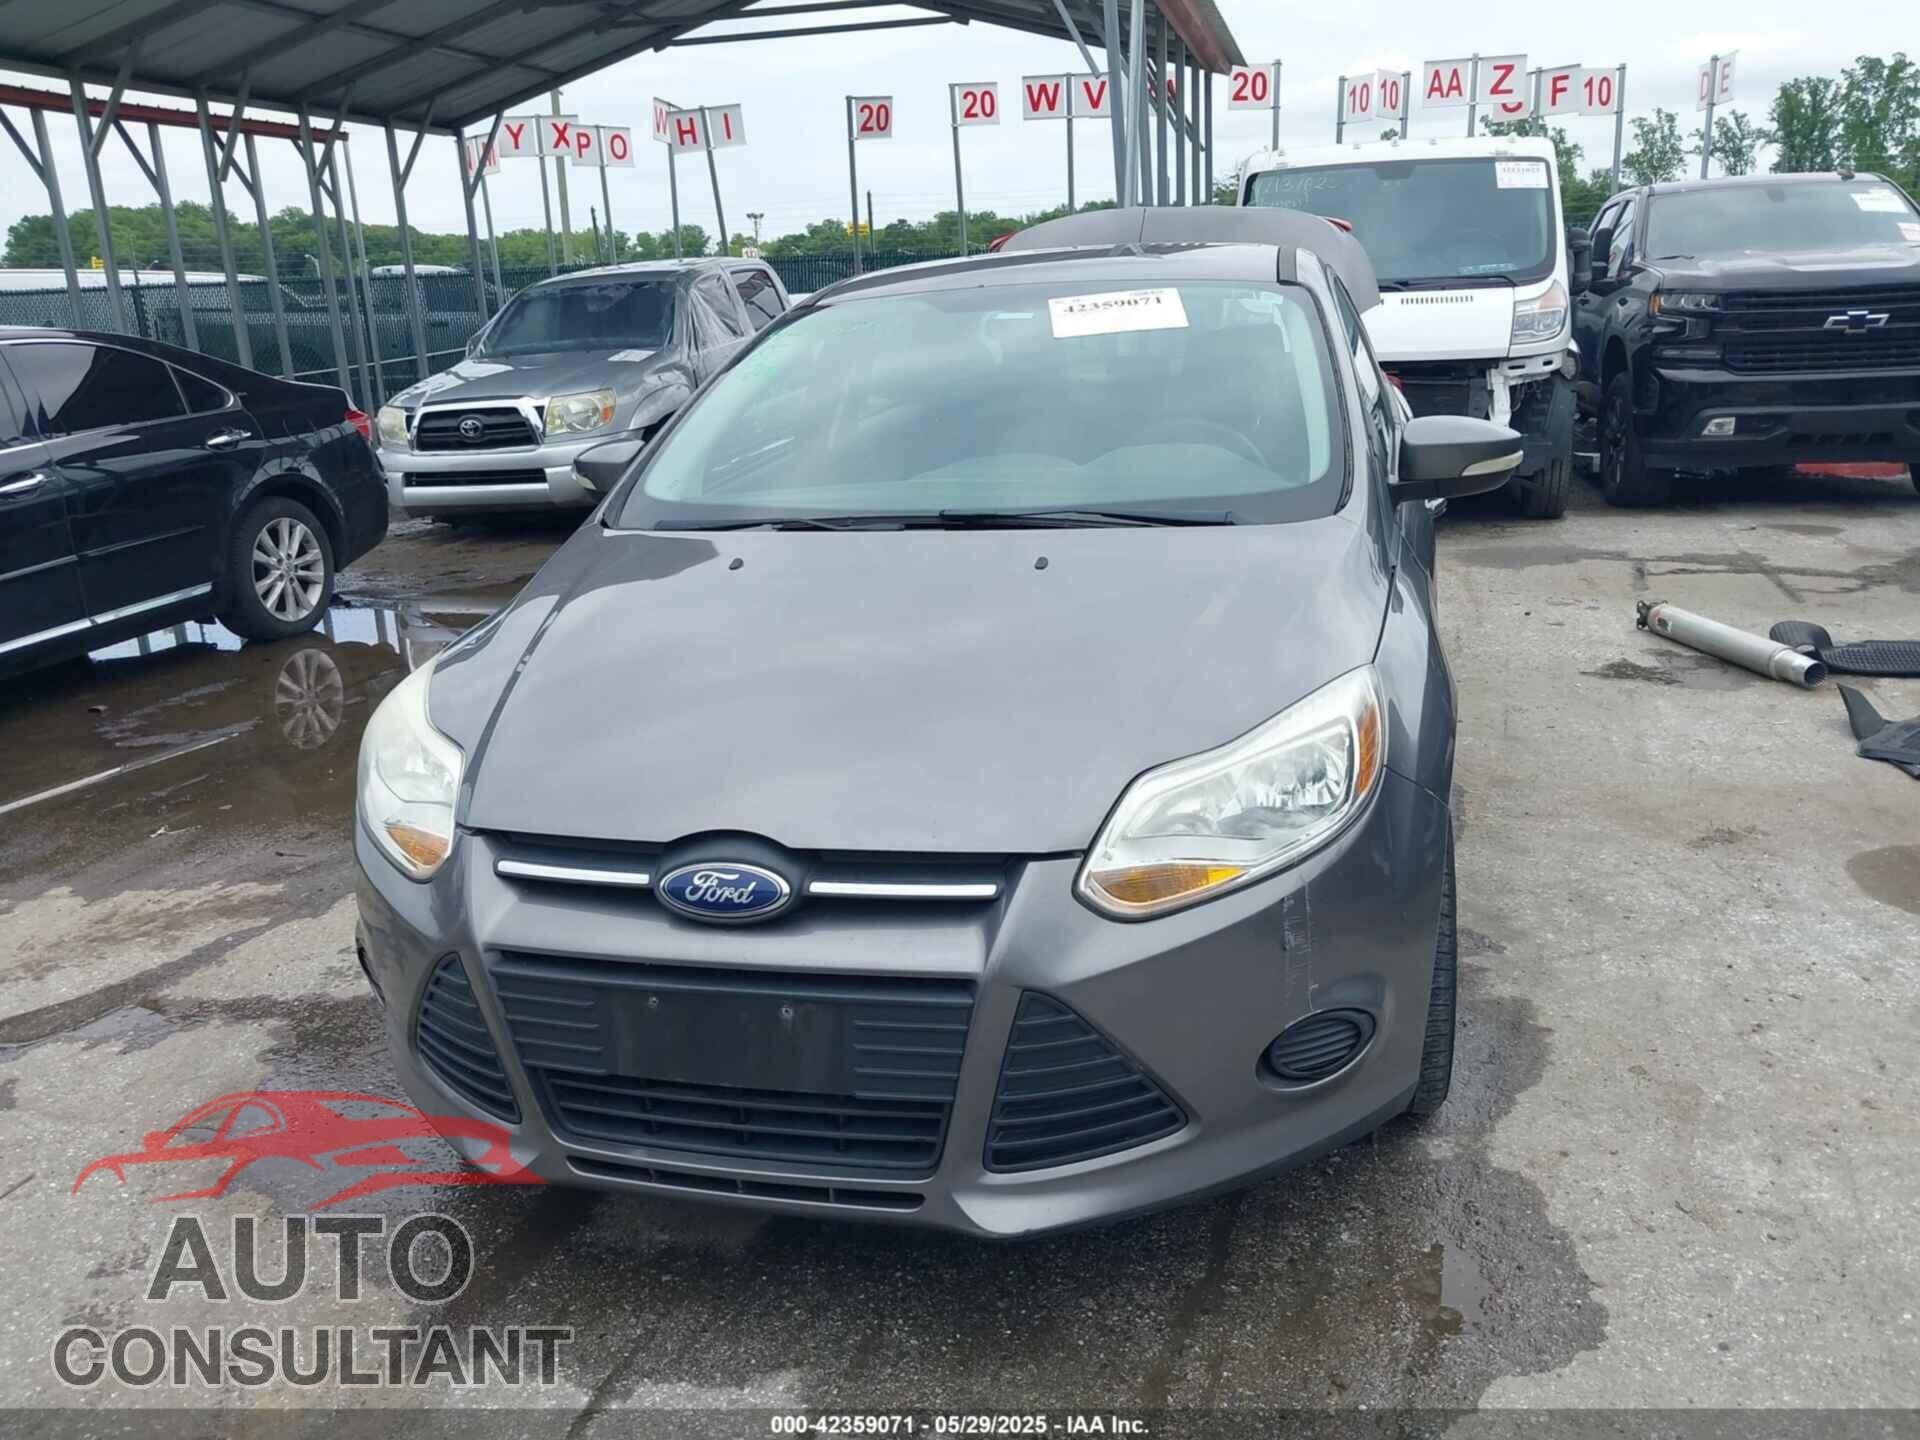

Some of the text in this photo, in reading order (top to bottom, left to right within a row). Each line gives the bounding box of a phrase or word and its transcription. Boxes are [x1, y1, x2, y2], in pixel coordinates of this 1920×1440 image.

[1231, 70, 1269, 102] 20
[1426, 68, 1463, 99] AA
[1489, 63, 1516, 96] Z
[1550, 74, 1570, 107] F
[1583, 76, 1612, 107] 10
[1720, 61, 1731, 95] E
[962, 89, 996, 119] 20
[1025, 81, 1061, 113] W
[1082, 80, 1107, 111] V
[1349, 83, 1370, 114] 10
[1380, 78, 1399, 110] 10
[675, 117, 698, 146] H
[722, 112, 732, 140] I
[859, 103, 890, 132] 20
[505, 123, 525, 150] Y
[551, 122, 572, 149] X
[576, 132, 592, 159] P
[1063, 295, 1163, 314] 42359071
[685, 870, 758, 904] Ford
